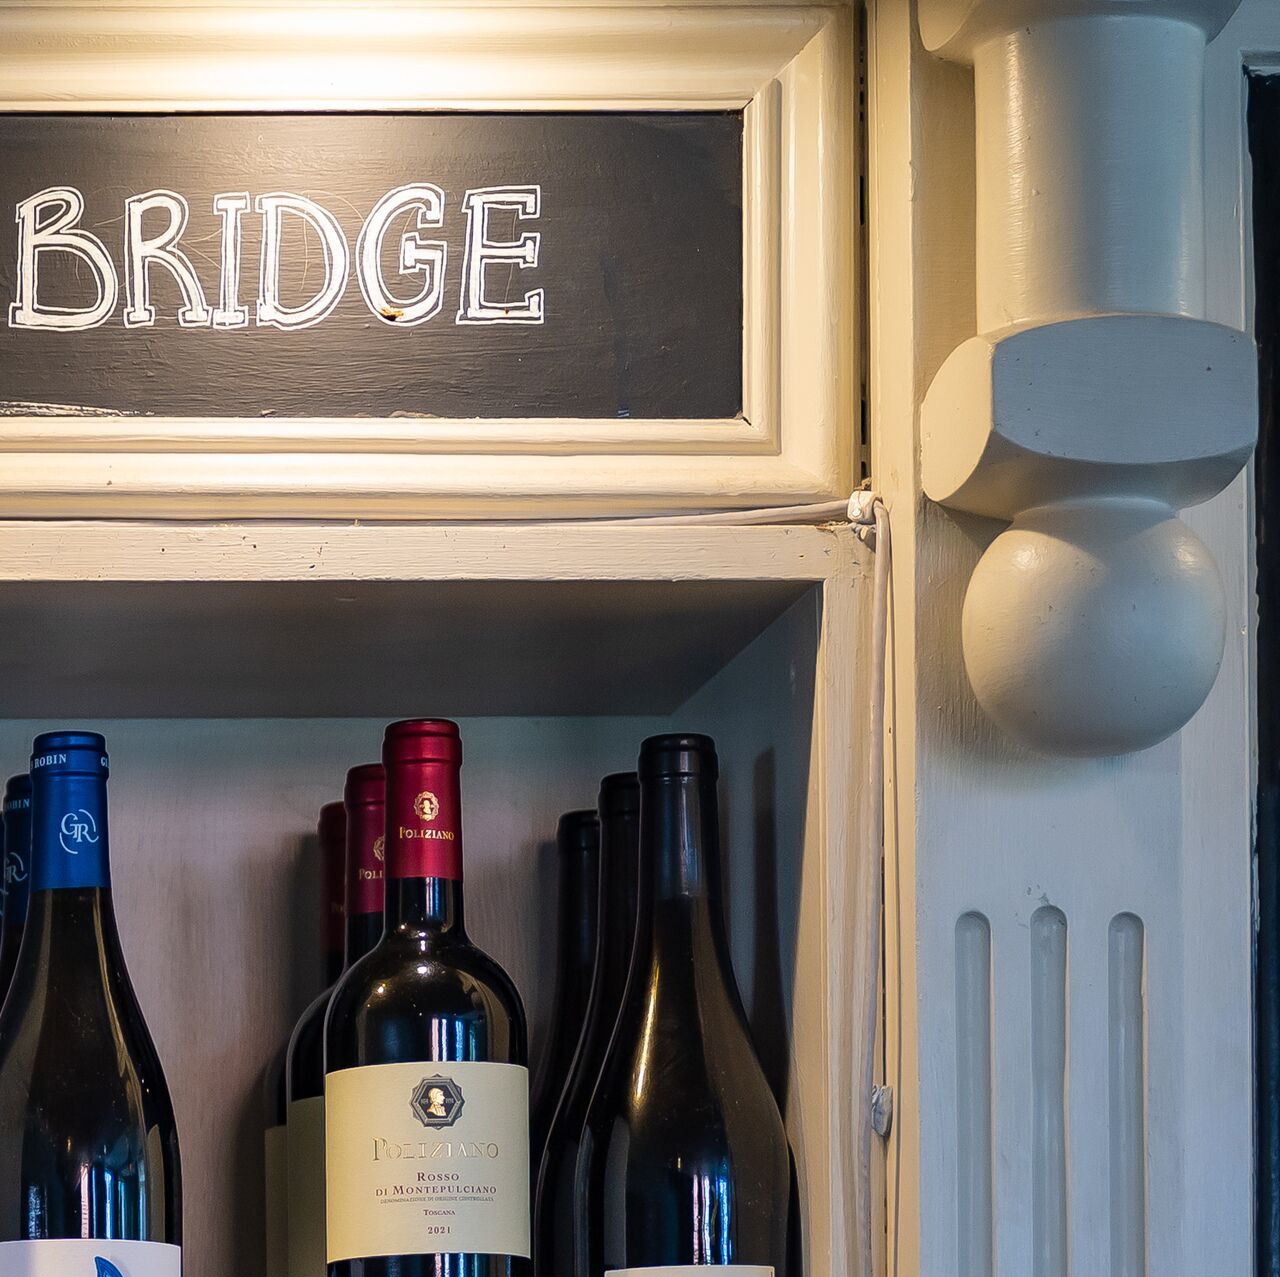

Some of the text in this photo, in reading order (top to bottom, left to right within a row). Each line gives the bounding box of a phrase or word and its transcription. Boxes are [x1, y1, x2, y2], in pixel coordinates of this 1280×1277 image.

[8, 183, 545, 332] BRIDGE
[34, 753, 67, 768] ROBIN
[399, 826, 455, 841] POLIZIANO
[372, 1136, 500, 1162] POLIZIANO
[417, 1172, 460, 1182] ROSSO
[376, 1185, 497, 1196] DI MONTEPULCIANO
[427, 1226, 451, 1235] 2021
